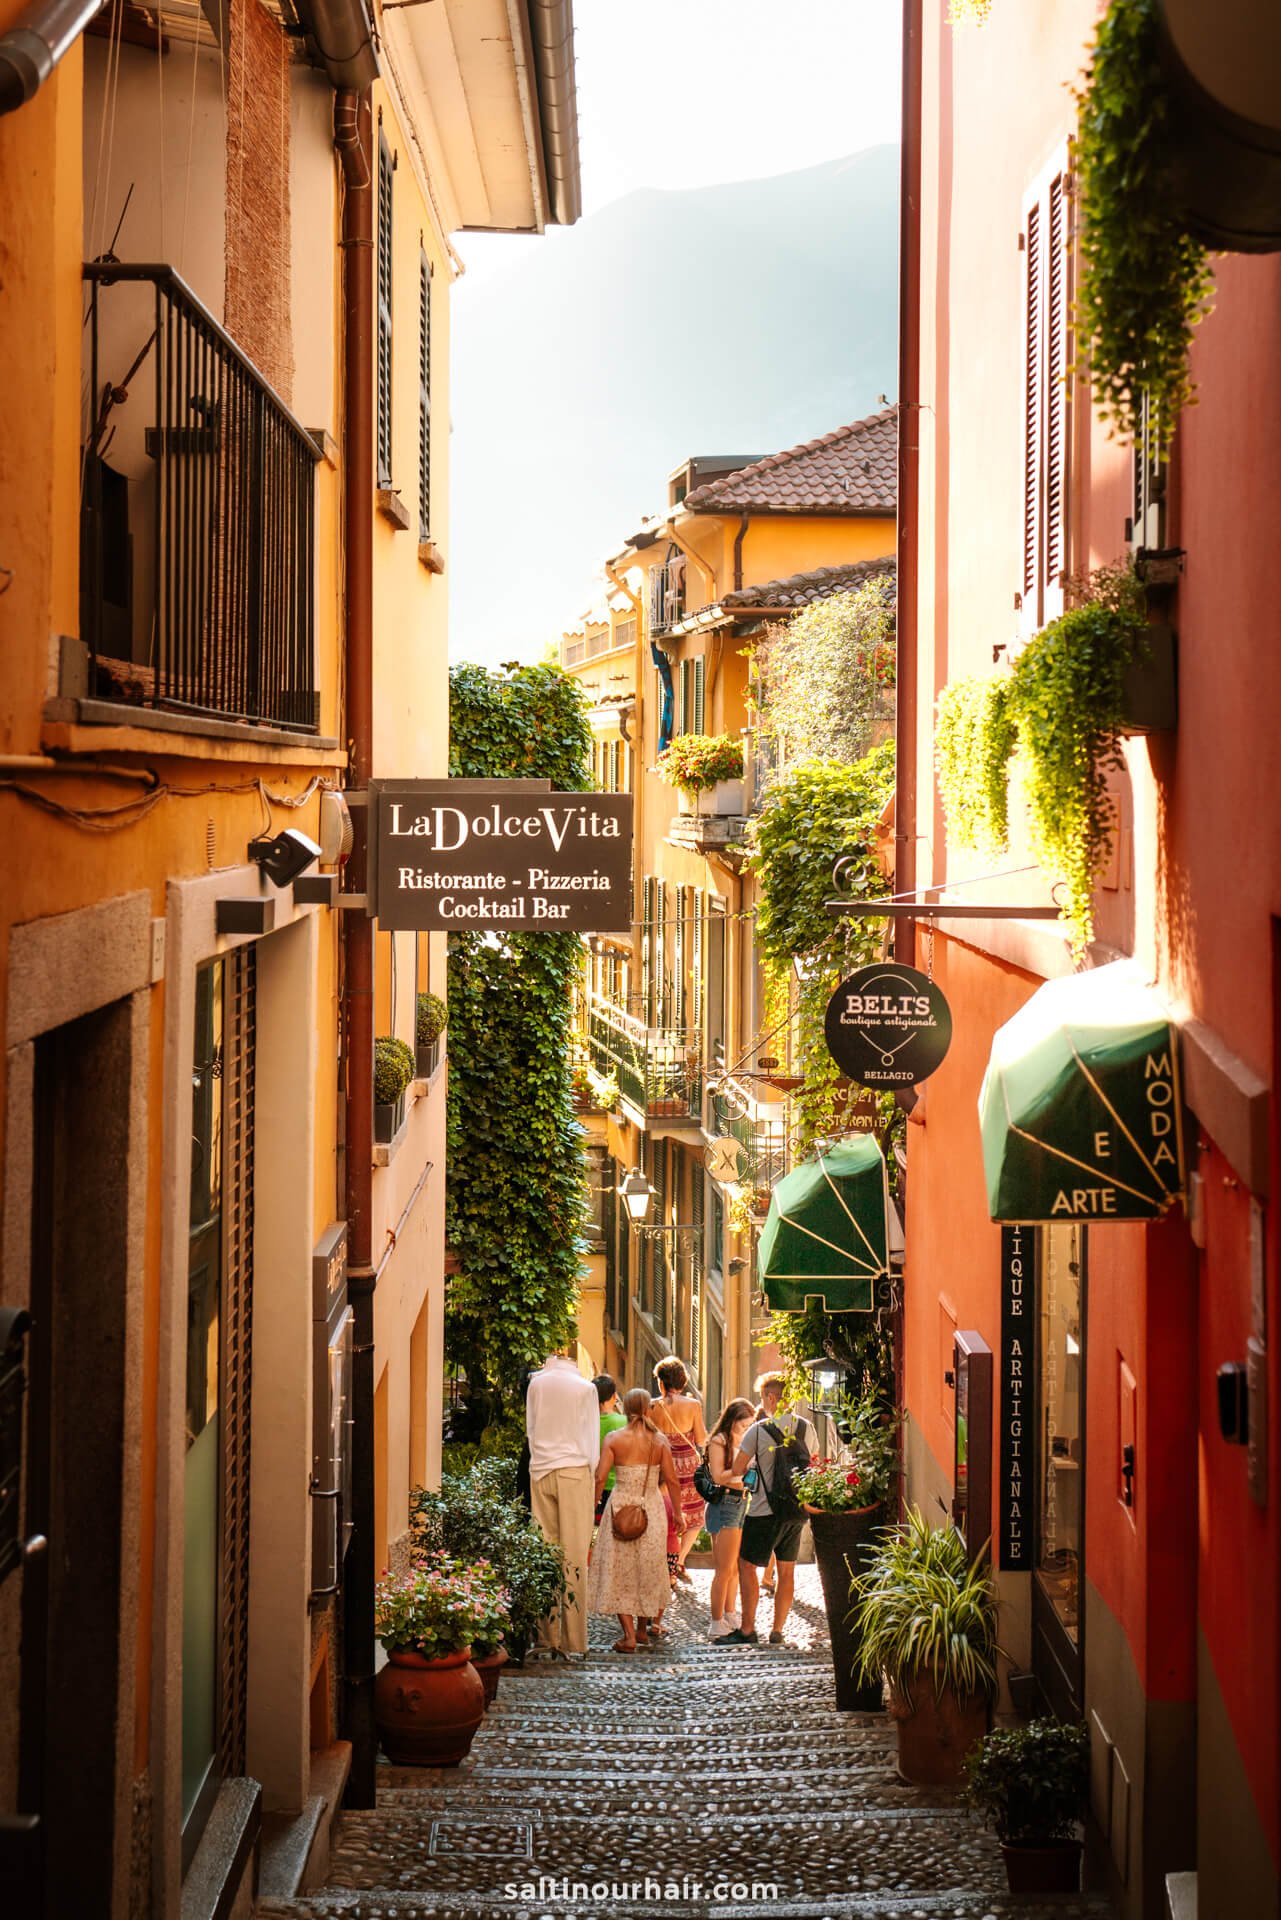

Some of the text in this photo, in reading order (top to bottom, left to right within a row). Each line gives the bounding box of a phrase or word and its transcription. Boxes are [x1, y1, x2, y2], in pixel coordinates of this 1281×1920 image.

[398, 867, 506, 890] Ristorante
[527, 868, 611, 890] Pizzeria
[438, 896, 571, 919] Cocktail Bar
[846, 995, 930, 1016] BELI'S
[840, 1012, 938, 1031] boutique artigianale
[864, 1071, 914, 1080] BELLAGIO
[1144, 1052, 1176, 1166] MODA
[1094, 1131, 1110, 1158] E
[1051, 1188, 1117, 1215] ARTE
[1010, 1339, 1023, 1558] ARTIGIANALE
